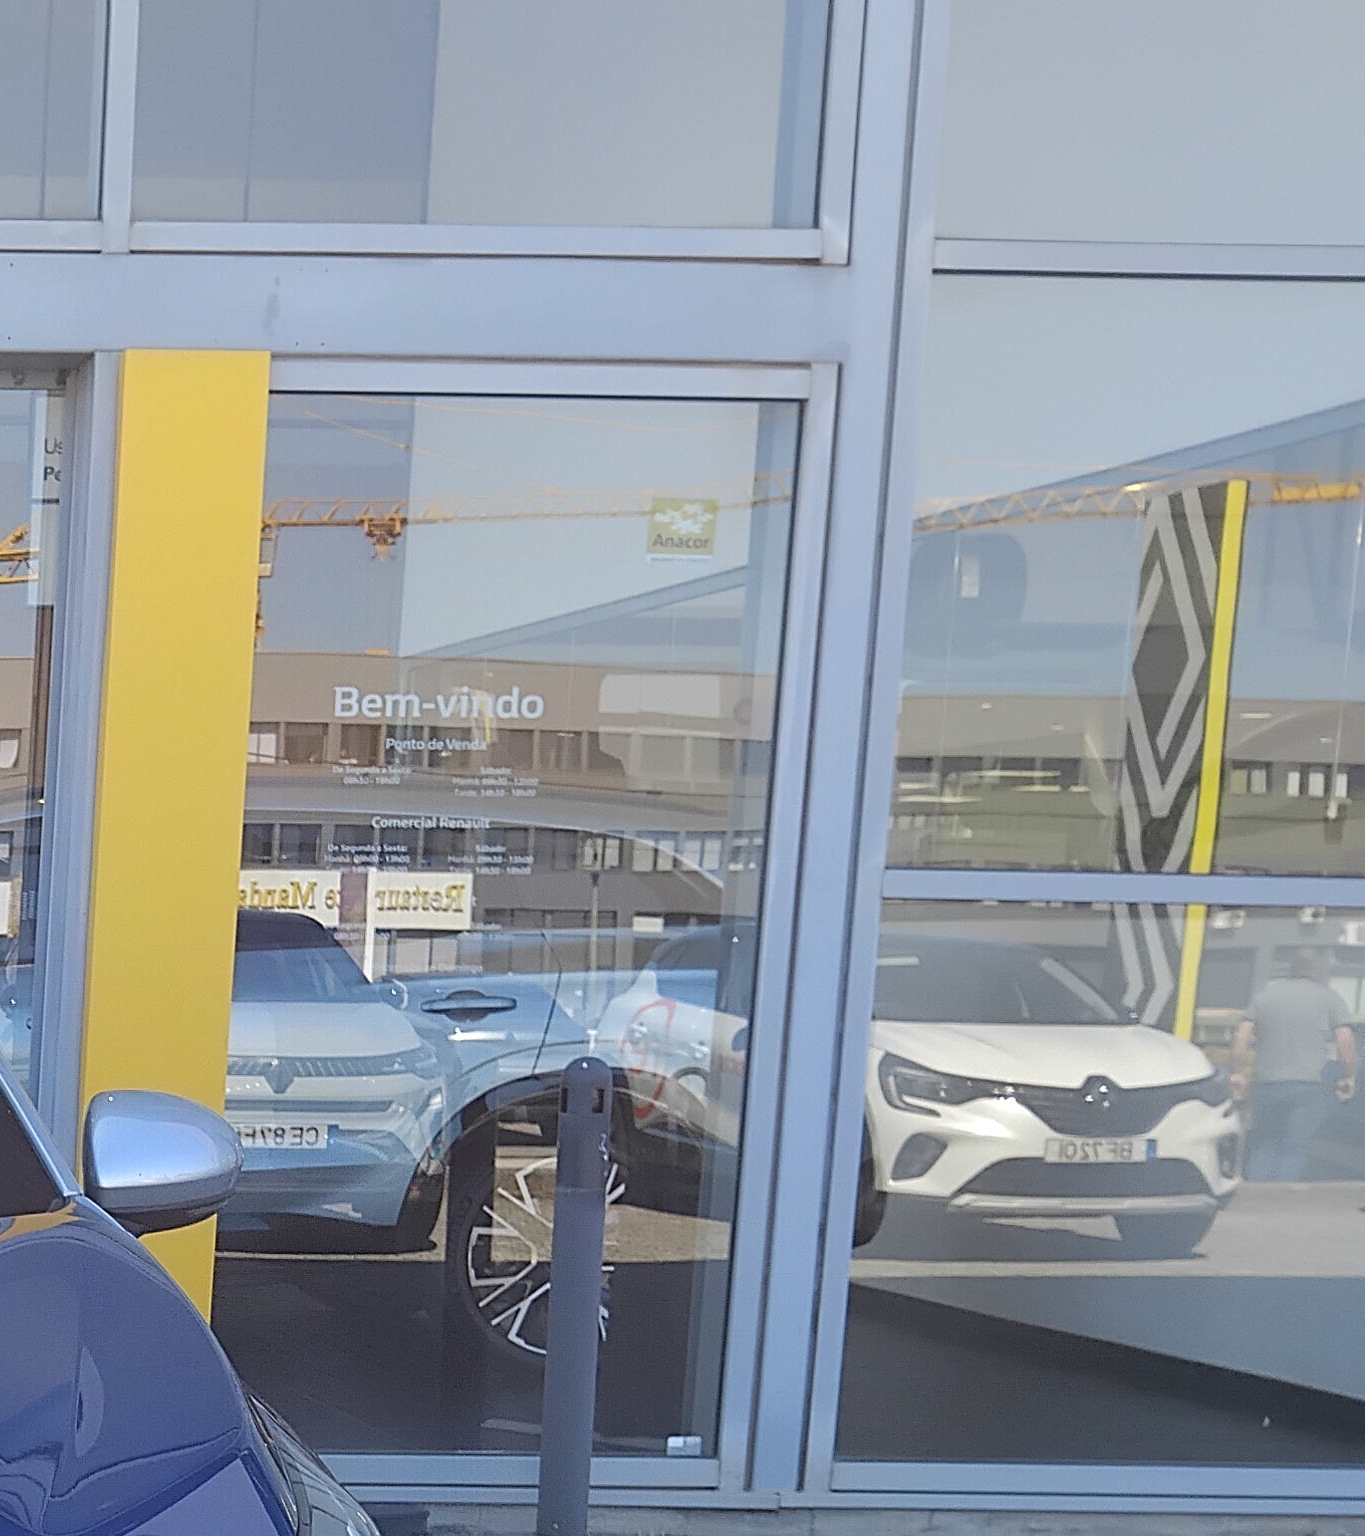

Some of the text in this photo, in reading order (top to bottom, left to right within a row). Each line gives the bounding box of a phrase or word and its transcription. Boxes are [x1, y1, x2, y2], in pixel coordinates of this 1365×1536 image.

[652, 533, 710, 549] Anacor
[333, 685, 545, 720] Bem-vindo
[385, 738, 487, 751] Ponto de Venda
[371, 816, 491, 829] Comercial Renault
